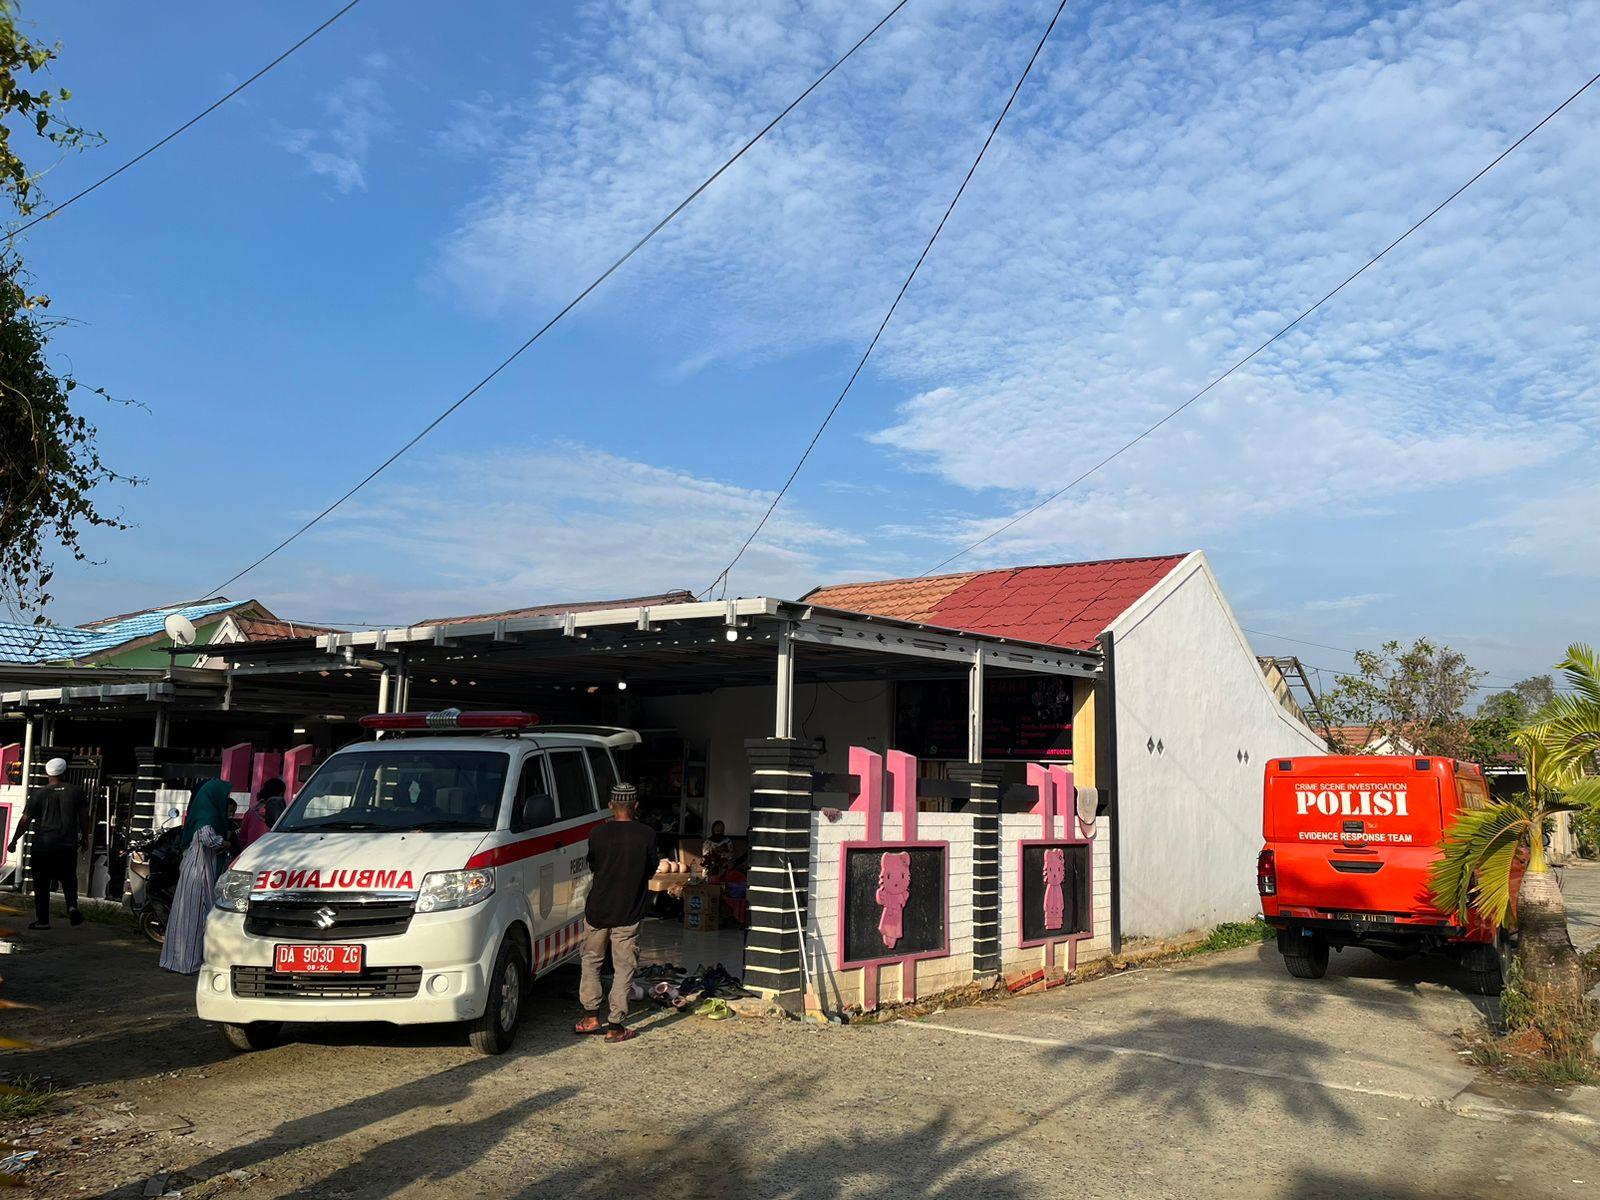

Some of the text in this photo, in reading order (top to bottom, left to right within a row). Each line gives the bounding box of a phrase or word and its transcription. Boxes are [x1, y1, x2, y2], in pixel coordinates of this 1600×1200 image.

[1295, 783, 1407, 791] CRIME SCENE INVESTIGATION
[1296, 791, 1408, 816] POLISI
[1299, 832, 1412, 842] EVIDENCE RESPONSE TEAM
[280, 947, 358, 964] DA 9030 ZG
